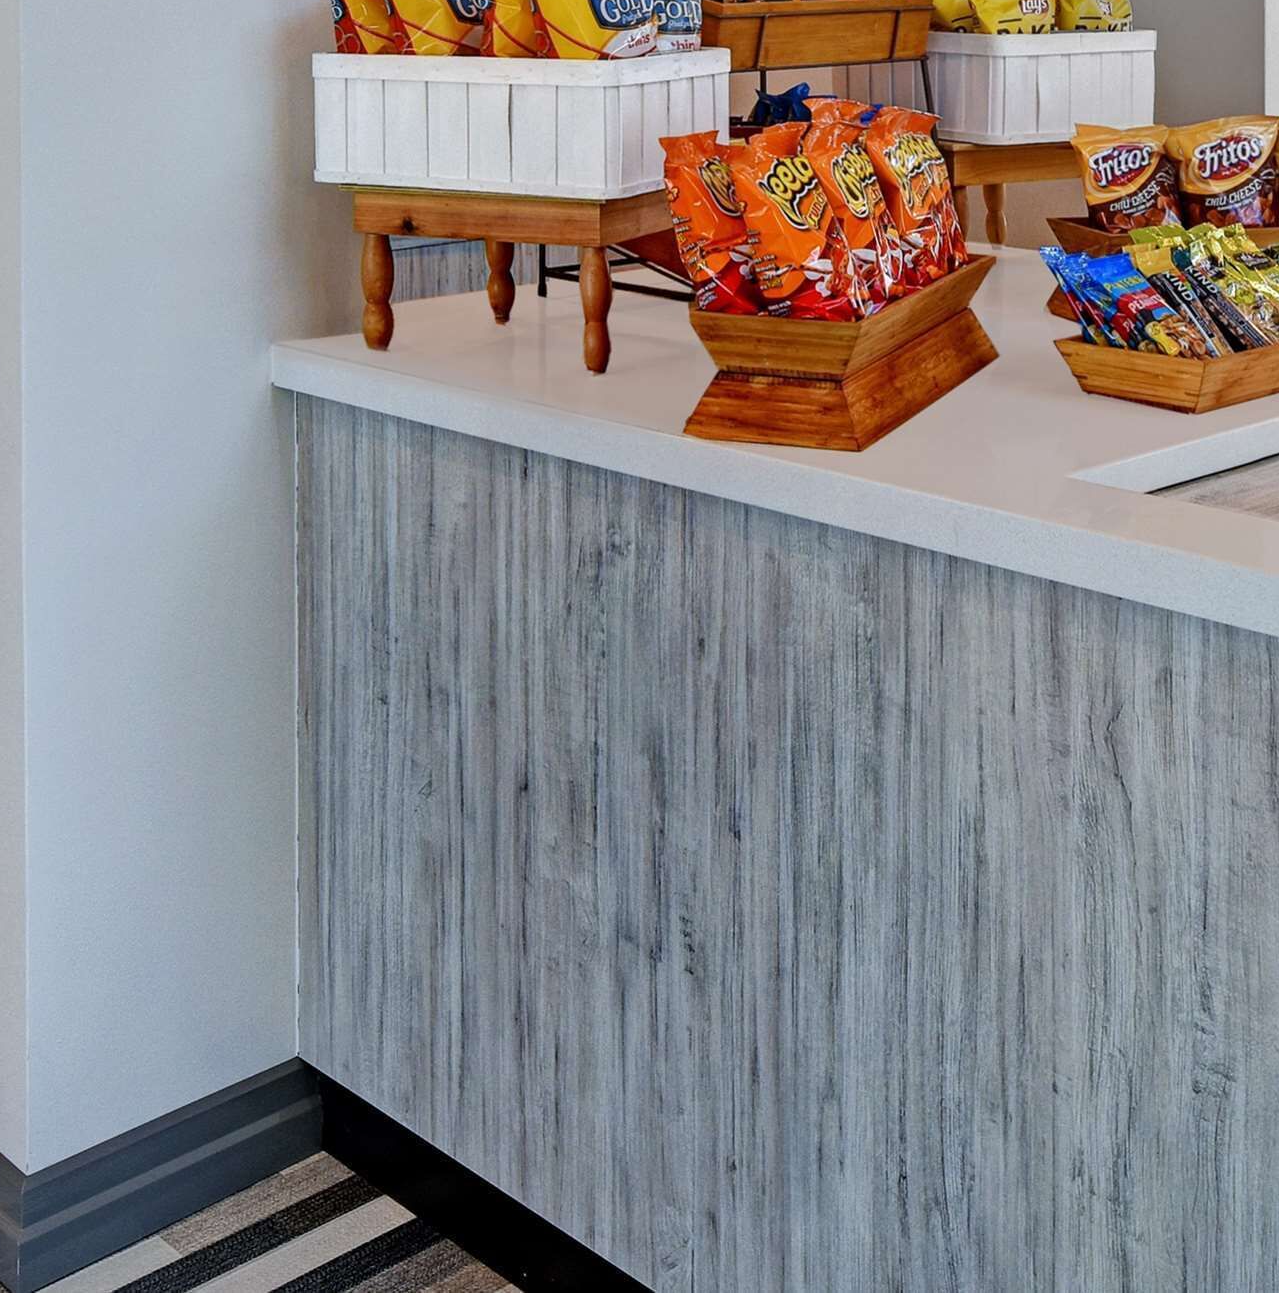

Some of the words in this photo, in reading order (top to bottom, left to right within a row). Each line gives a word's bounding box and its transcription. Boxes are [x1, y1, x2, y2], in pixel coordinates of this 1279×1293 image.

[654, 0, 703, 26] GOLD
[1089, 146, 1153, 187] Fritos
[1193, 137, 1263, 178] Fritos
[1109, 196, 1130, 212] CHILI
[1131, 181, 1161, 209] CHEESE
[1205, 195, 1227, 207] CHILI
[1229, 178, 1263, 204] CHEESE
[1163, 270, 1193, 301] KIND
[1184, 265, 1218, 294] KIND
